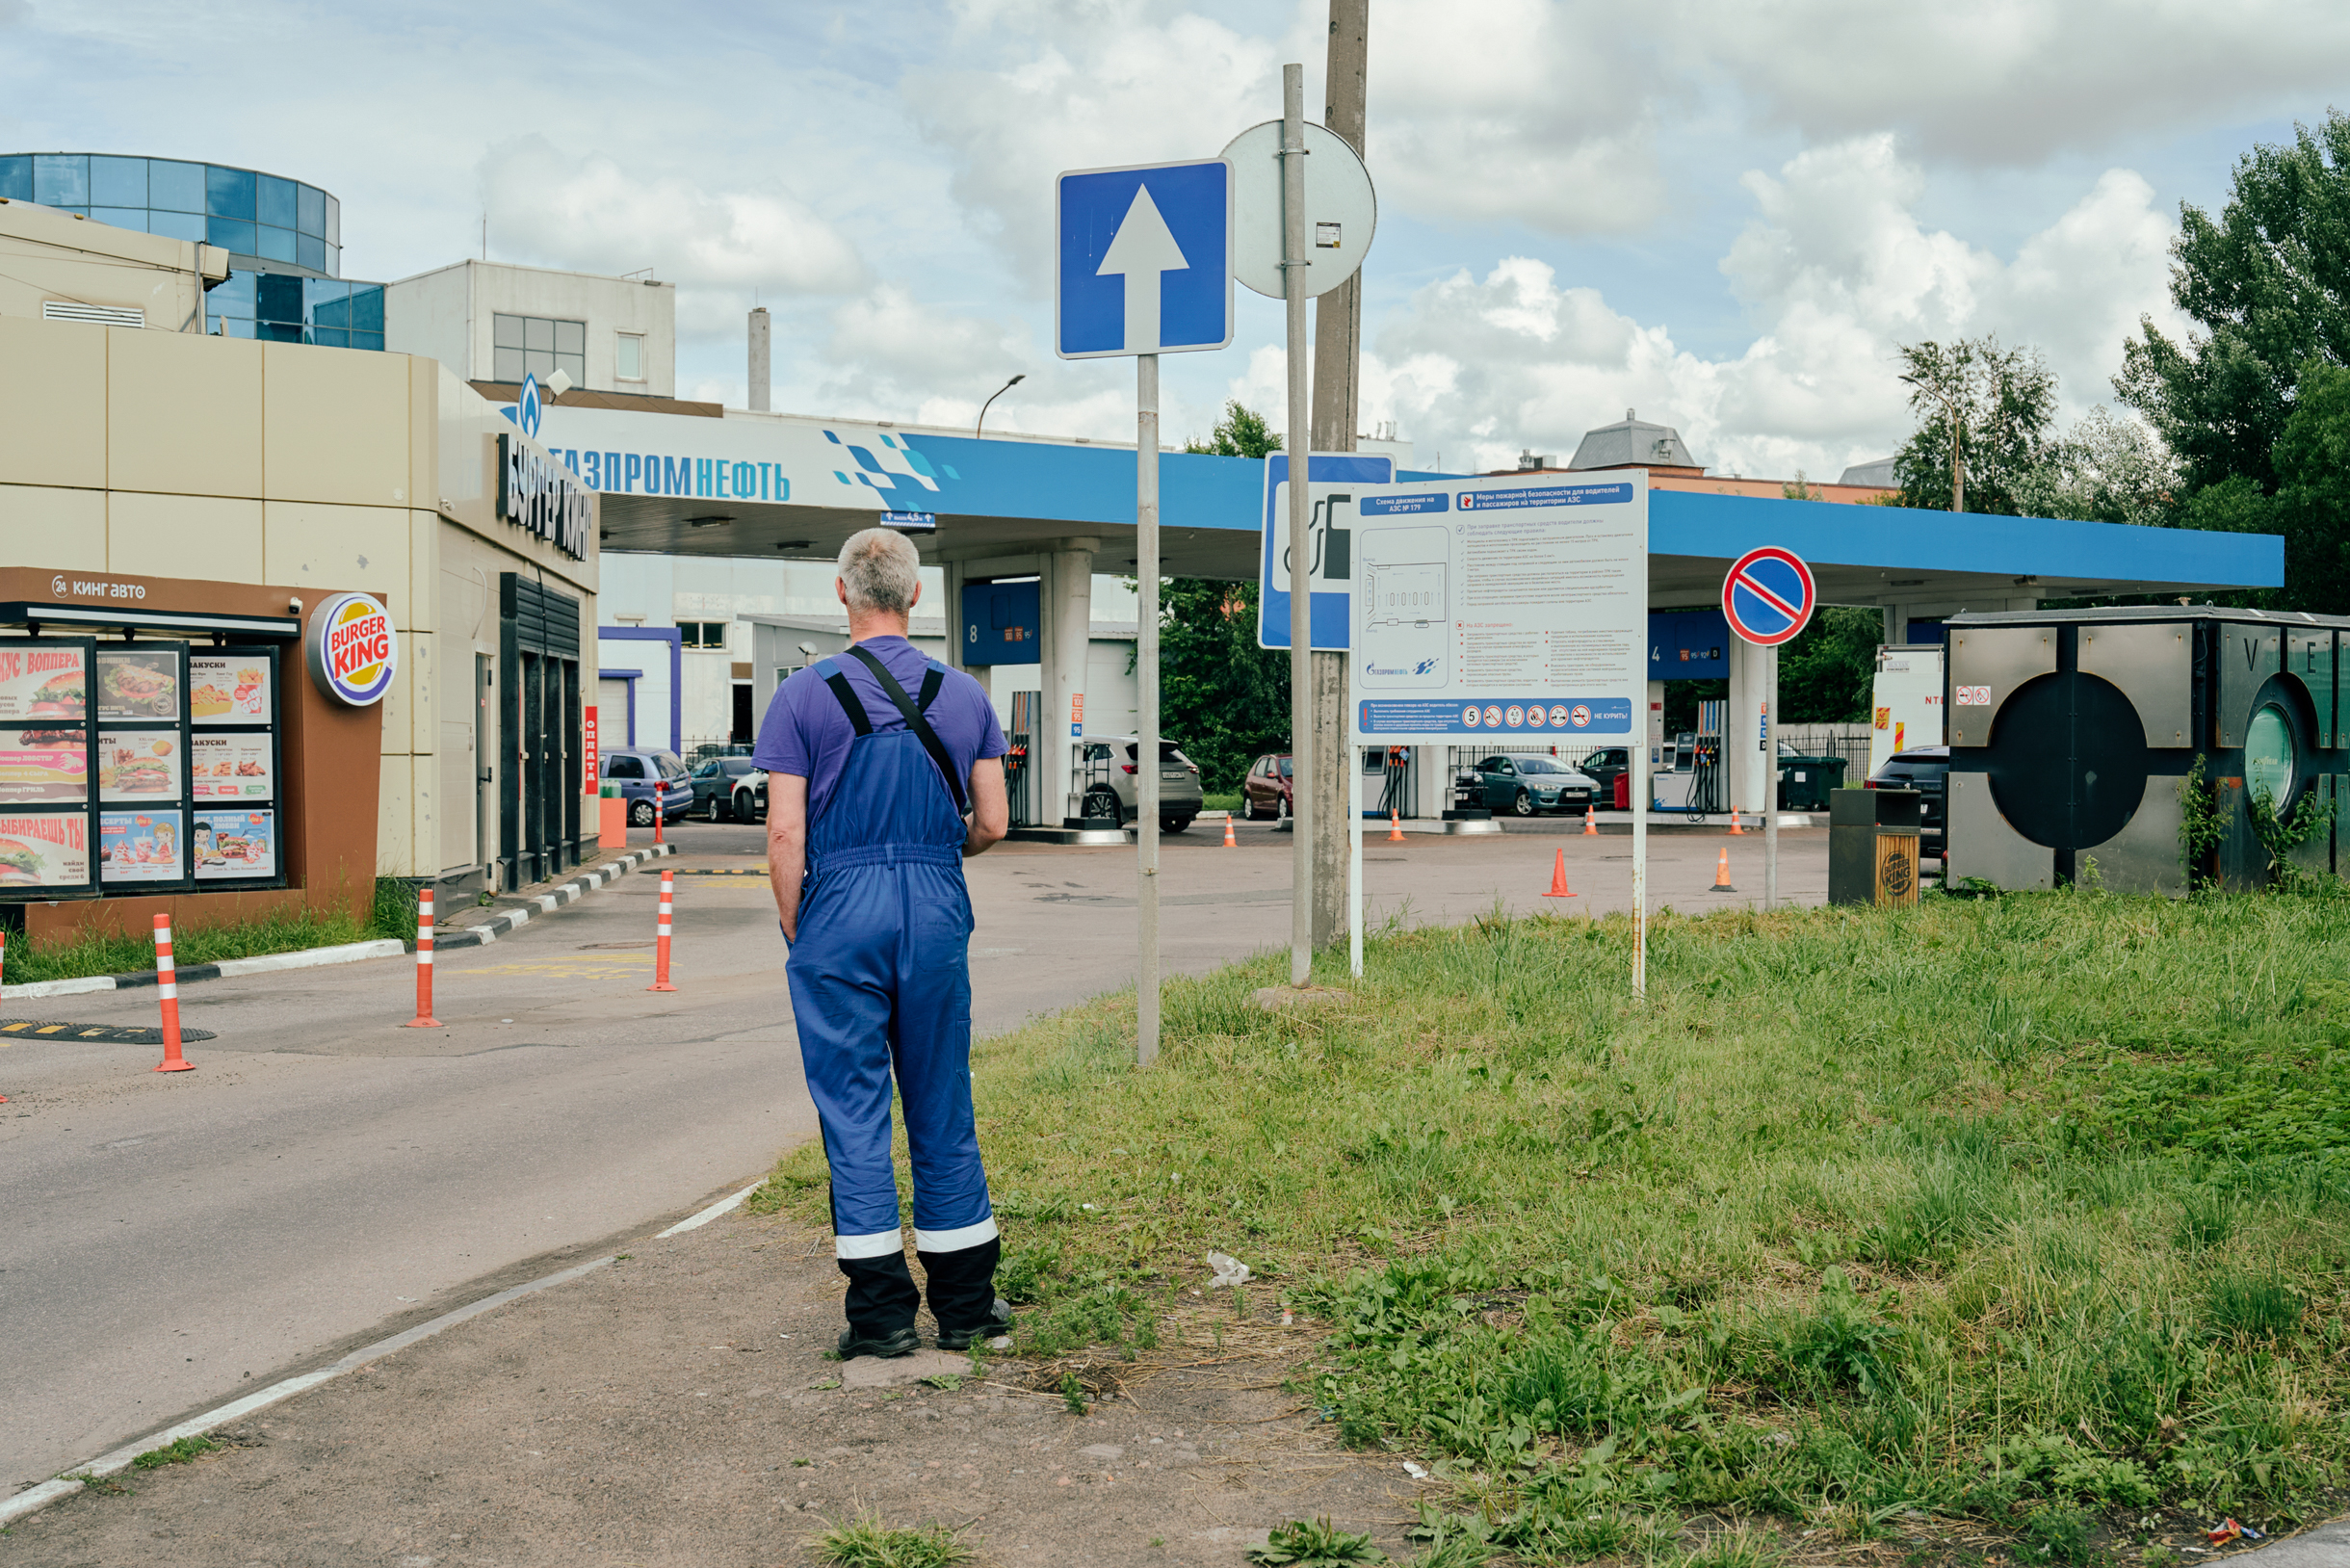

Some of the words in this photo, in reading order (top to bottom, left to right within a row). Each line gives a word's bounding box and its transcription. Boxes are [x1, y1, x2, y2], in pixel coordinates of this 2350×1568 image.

[503, 433, 561, 541] БУРГЕР
[1496, 491, 1527, 499] пожарной
[1585, 486, 1620, 495] водителей
[907, 512, 919, 522] 4,5
[55, 580, 66, 593] 24
[332, 615, 386, 652] BURGER
[970, 625, 977, 643] 8
[1016, 631, 1022, 640] 95
[334, 634, 389, 679] KING
[1652, 646, 1660, 661] 4
[27, 652, 79, 675] ВОППЕРА
[1468, 711, 1475, 721] 5
[586, 720, 595, 781] ОПЛАТА
[0, 819, 65, 845] ЫБИРАЕШЬ
[67, 818, 84, 852] ТЫ
[1885, 858, 1909, 875] BURGER
[1886, 867, 1910, 887] KING
